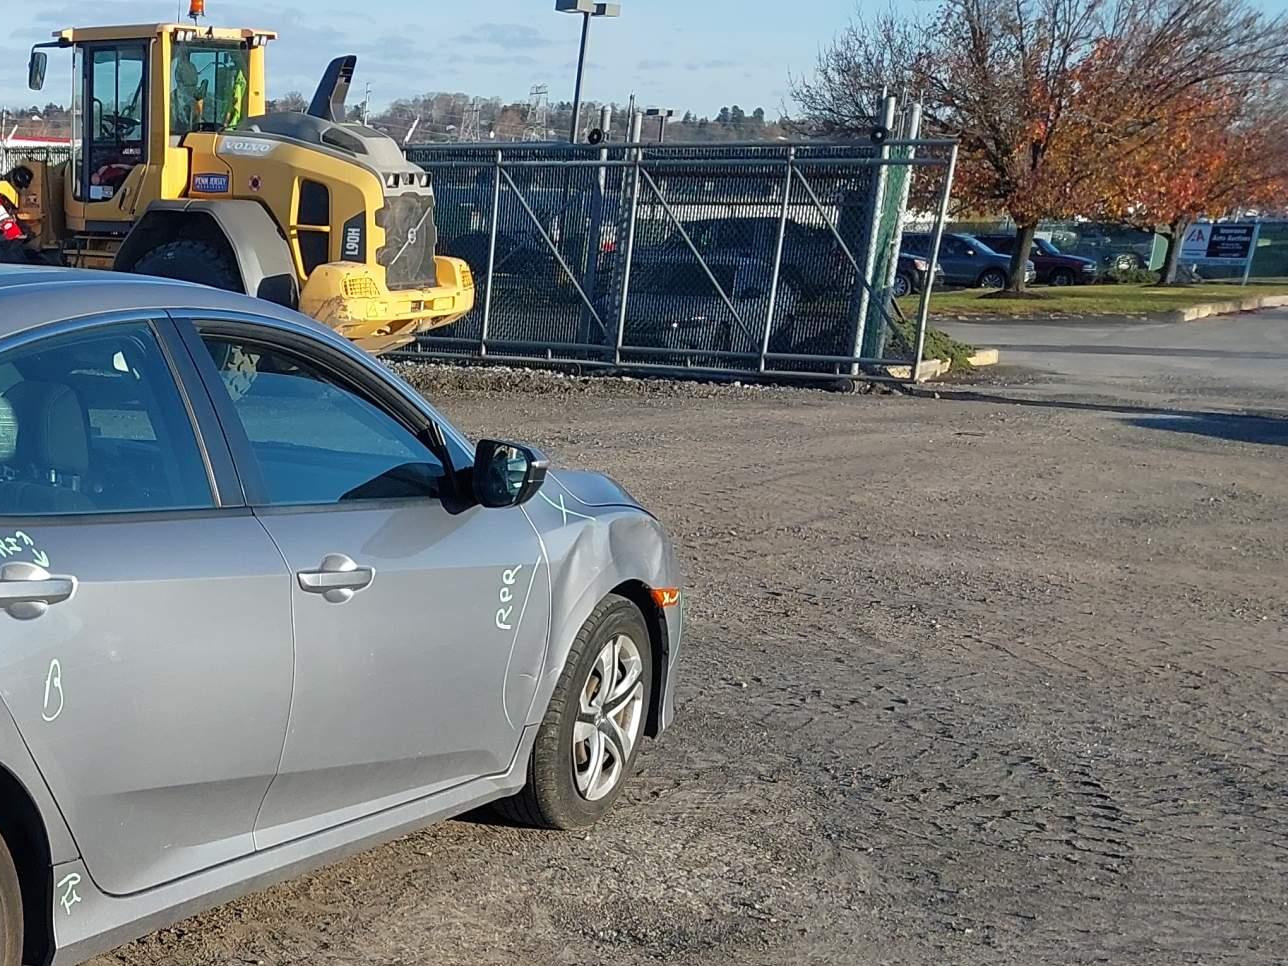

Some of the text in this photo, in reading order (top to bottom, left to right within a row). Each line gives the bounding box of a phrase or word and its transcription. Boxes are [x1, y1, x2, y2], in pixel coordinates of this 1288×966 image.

[225, 141, 271, 152] VOLVO
[345, 227, 361, 256] L90H
[496, 564, 522, 630] RPR
